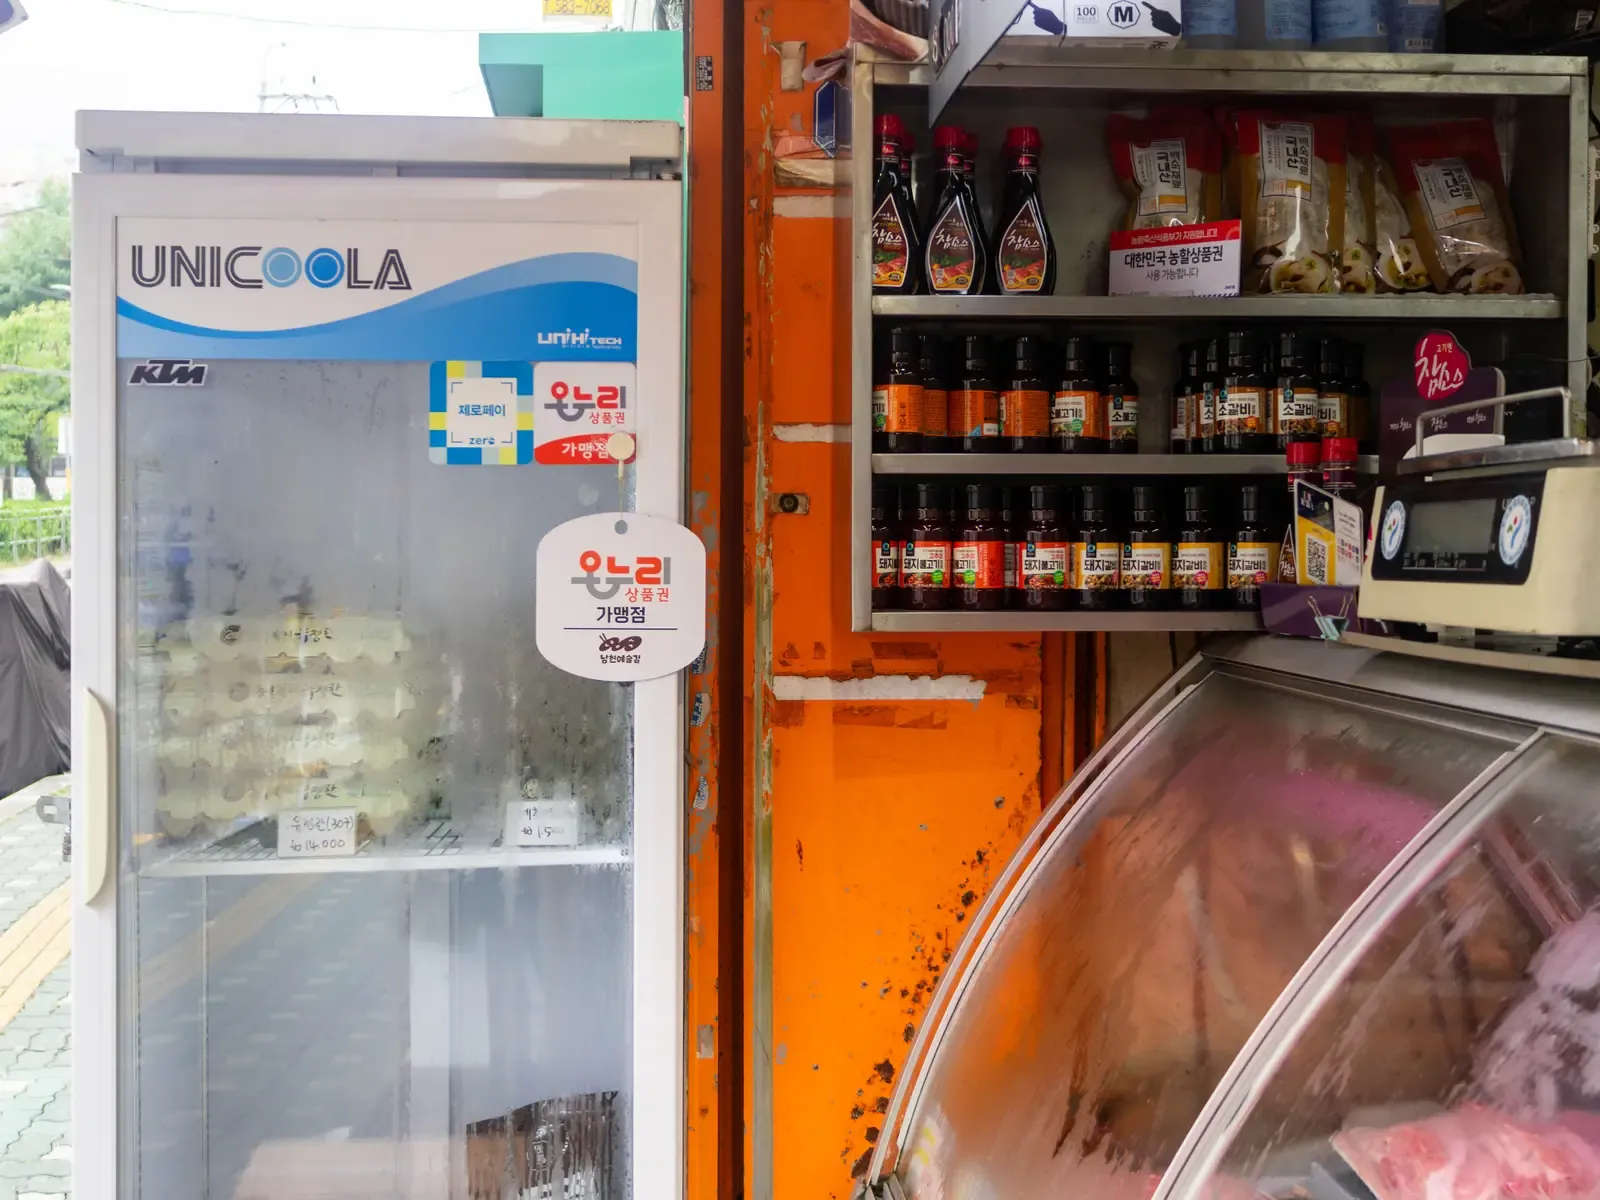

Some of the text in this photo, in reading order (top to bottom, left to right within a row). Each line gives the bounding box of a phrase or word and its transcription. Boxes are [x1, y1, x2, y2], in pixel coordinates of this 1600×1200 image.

[1076, 7, 1096, 16] 100
[1114, 6, 1133, 22] M
[935, 228, 968, 249] 참소스
[1007, 229, 1040, 250] 참소스
[1124, 245, 1223, 268] 대한민국 농할상품권
[131, 244, 412, 290] UNICOOLA
[1145, 267, 1199, 281] 사용 가능합니다
[130, 357, 207, 386] KTM
[544, 381, 627, 422] 온누리
[458, 404, 506, 417] 제로페이
[1218, 403, 1251, 416] 소갈비
[1282, 404, 1314, 416] 소갈비
[589, 412, 625, 424] 상품권
[1122, 559, 1157, 571] 돼지갈비
[571, 550, 671, 600] 온누리
[625, 588, 669, 603] 상품권
[596, 607, 646, 624] 가맹점
[600, 654, 641, 664] 남현예술길
